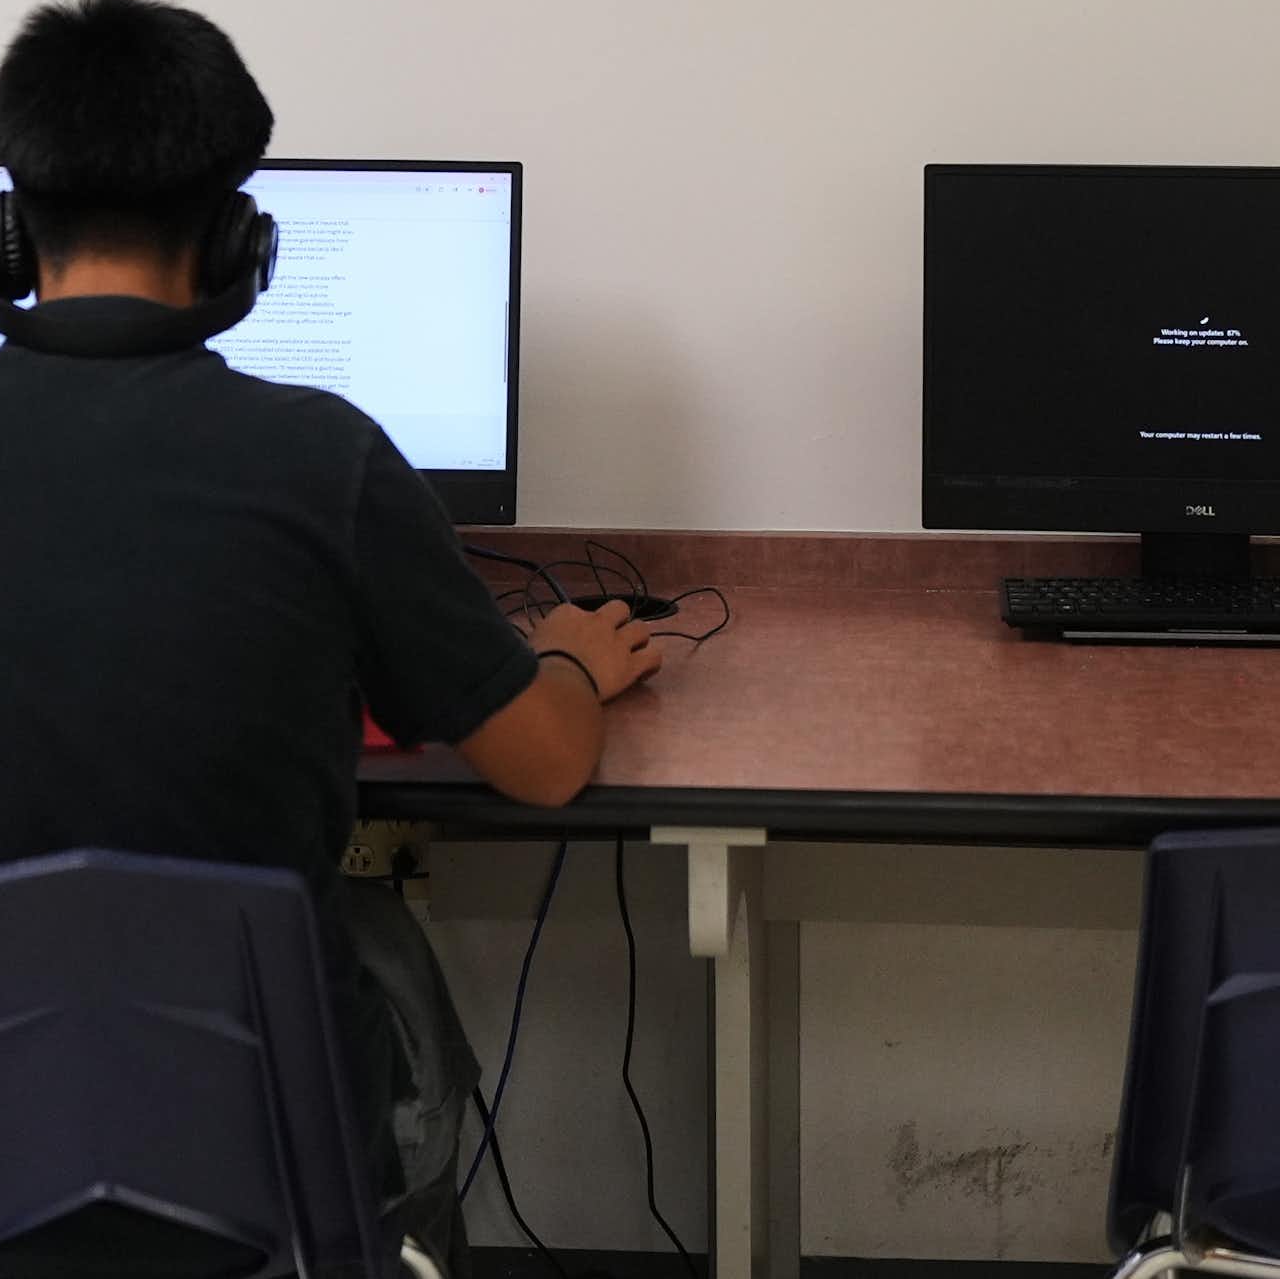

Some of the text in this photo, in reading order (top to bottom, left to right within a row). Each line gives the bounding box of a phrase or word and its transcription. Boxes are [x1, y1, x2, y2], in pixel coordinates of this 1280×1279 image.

[1161, 329, 1188, 337] Working
[1199, 329, 1224, 338] updates
[1185, 505, 1216, 516] DELL
